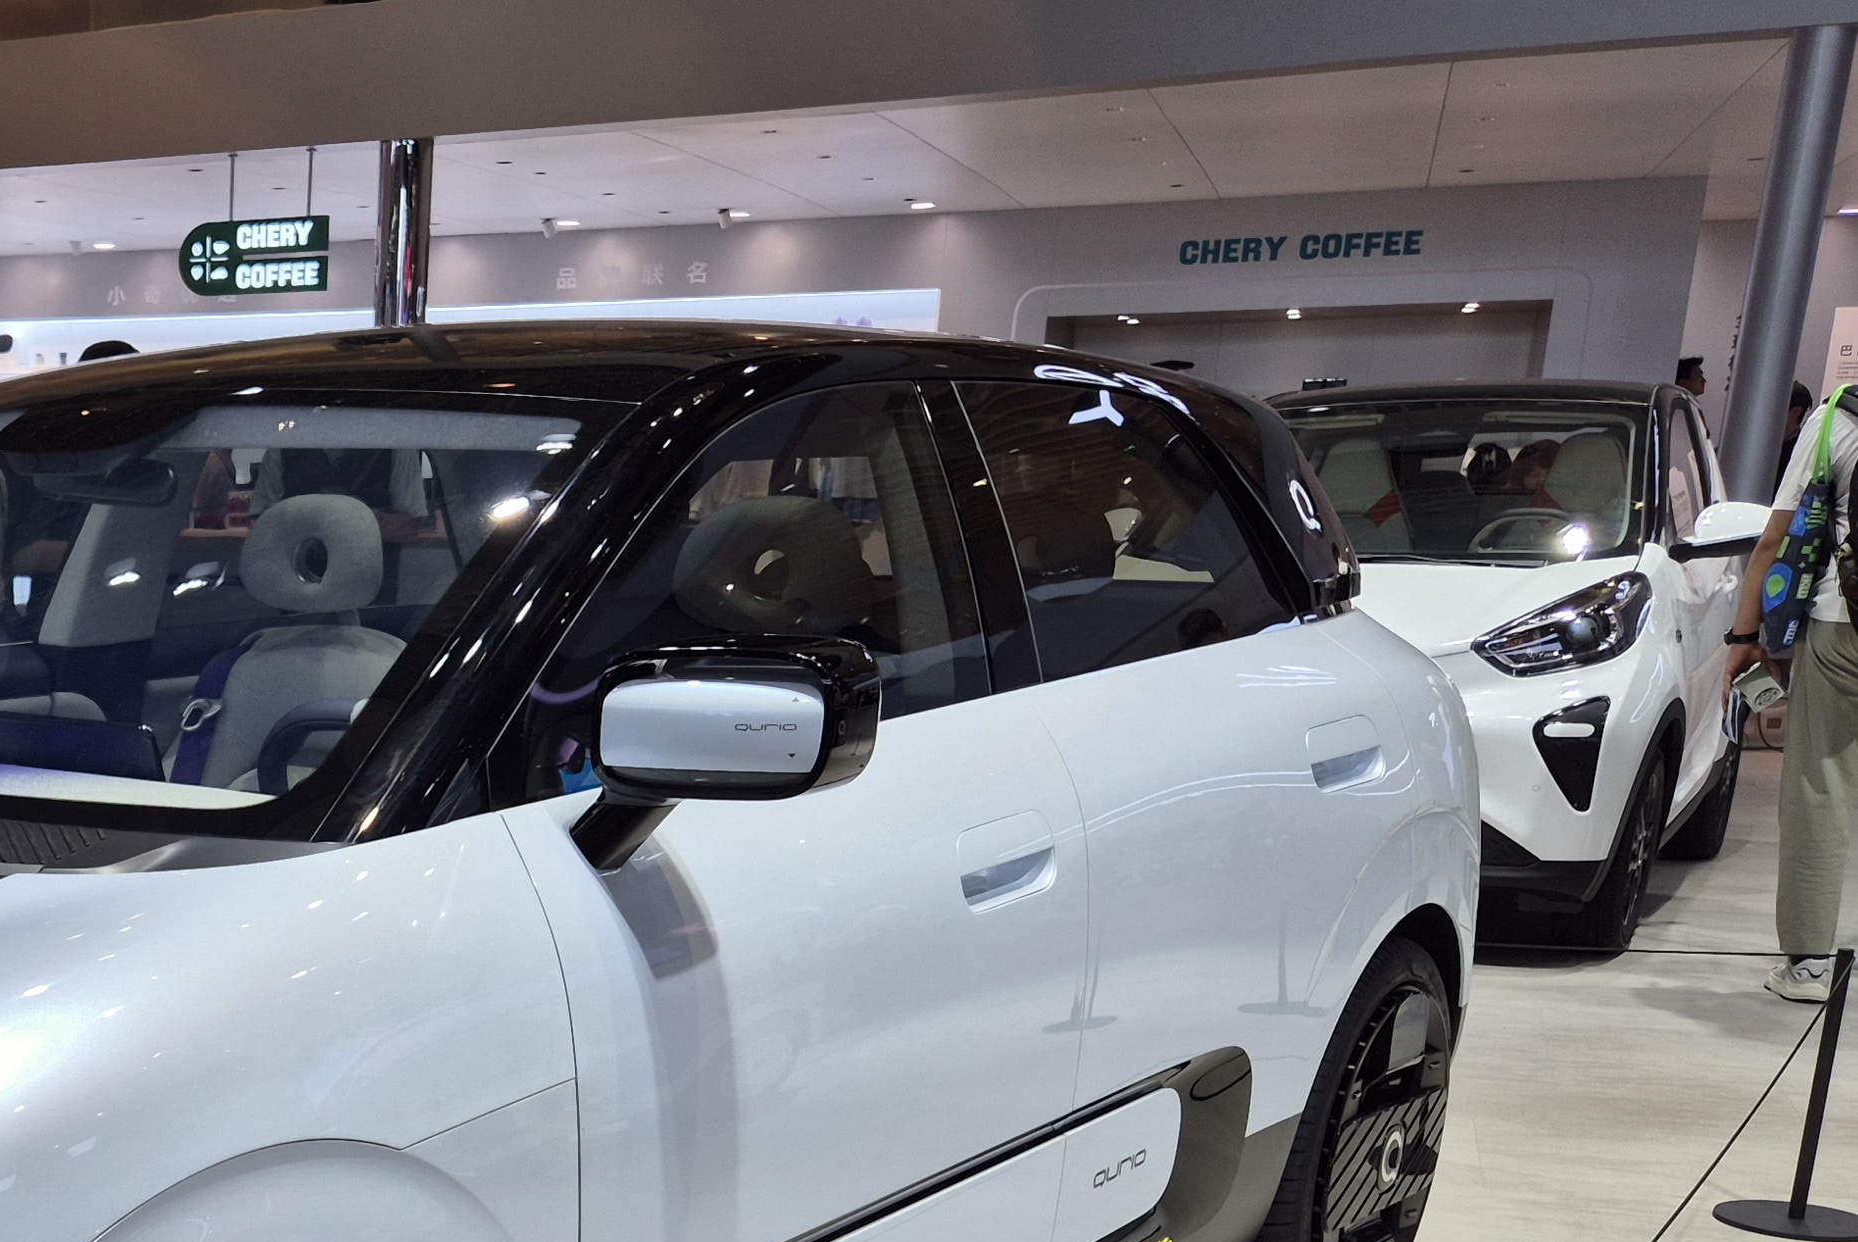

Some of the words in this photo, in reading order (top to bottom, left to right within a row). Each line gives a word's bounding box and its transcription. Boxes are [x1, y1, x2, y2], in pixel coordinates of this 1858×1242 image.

[236, 219, 314, 250] CHERY
[1179, 236, 1288, 266] CHERY
[1299, 229, 1424, 261] COFFEE
[235, 260, 321, 290] COFFEE
